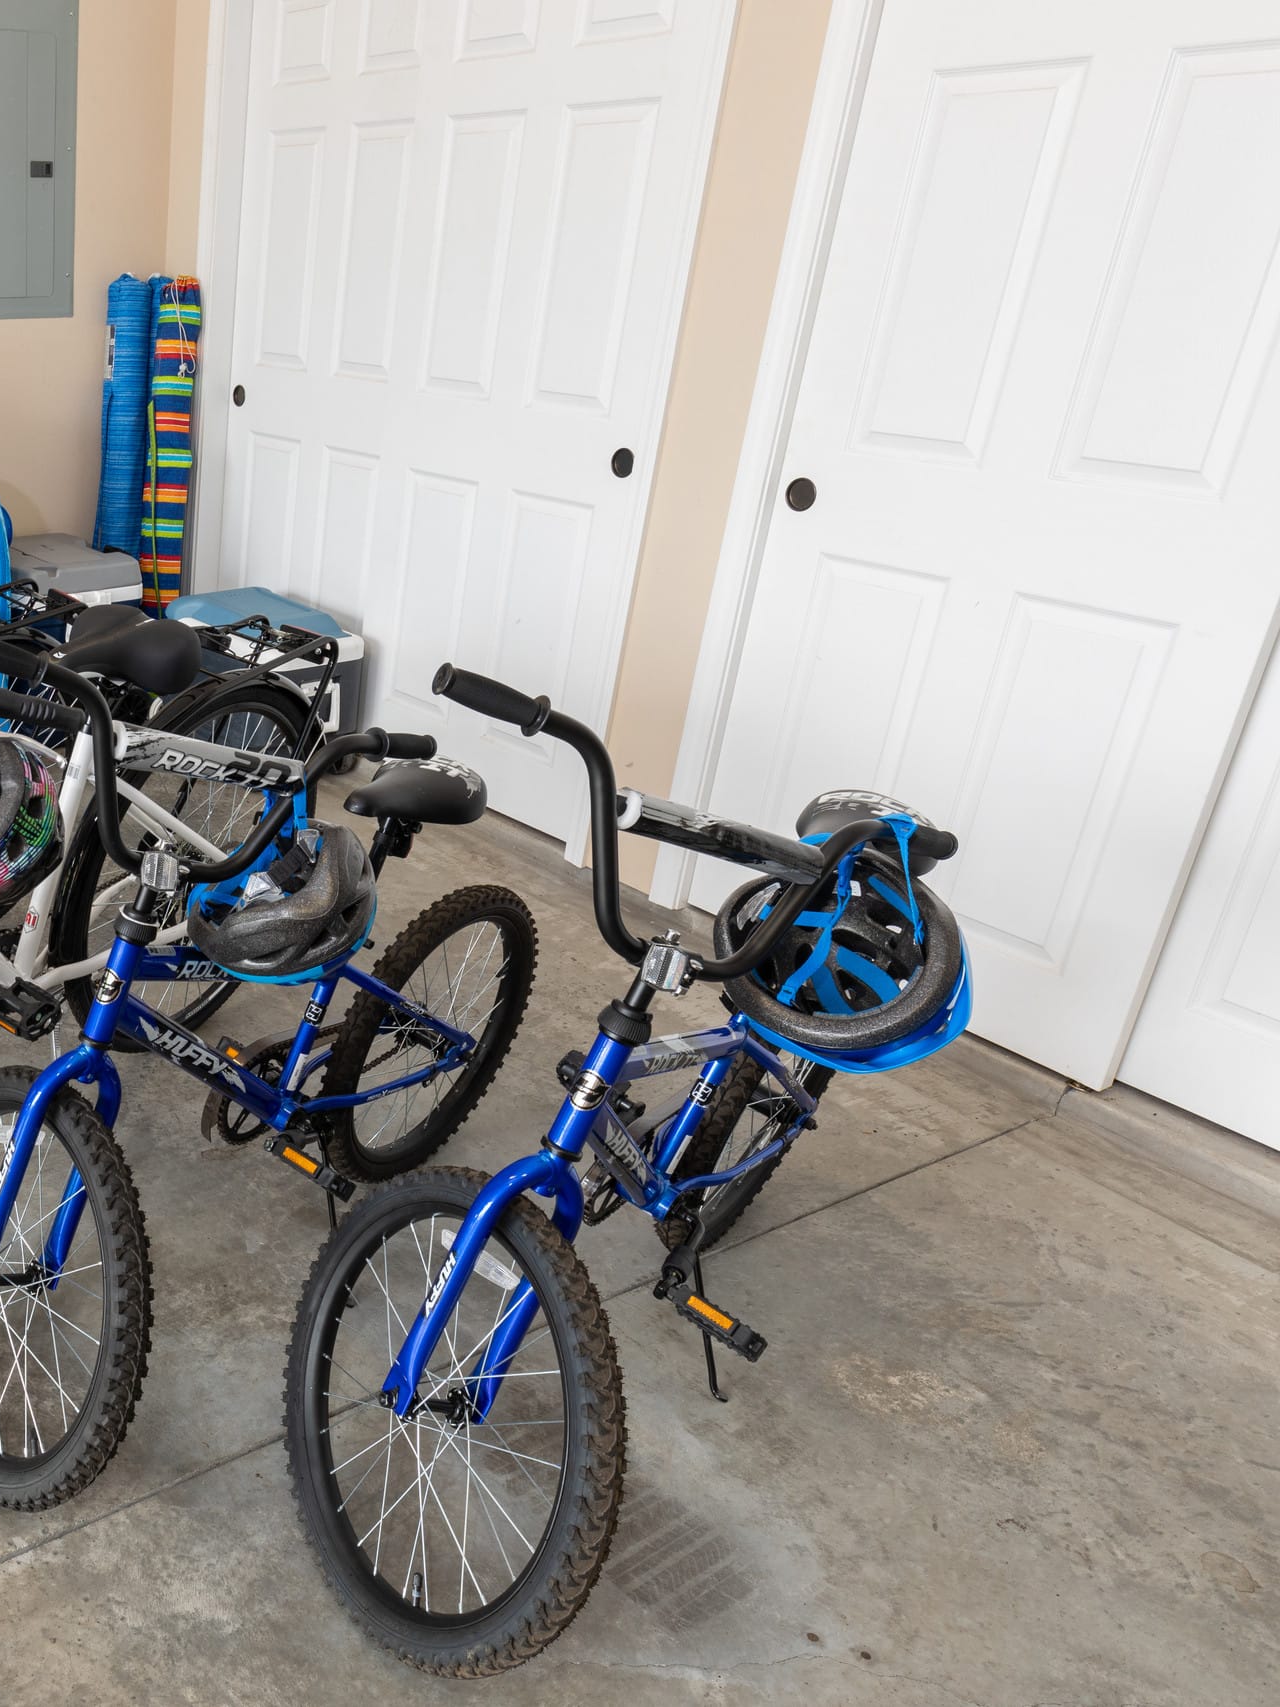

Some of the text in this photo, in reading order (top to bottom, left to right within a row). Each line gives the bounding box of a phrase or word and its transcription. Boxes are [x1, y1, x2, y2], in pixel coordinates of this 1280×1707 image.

[151, 748, 237, 782] ROCK
[154, 1029, 229, 1075] HUFFY
[605, 1129, 643, 1171] HUFFY
[425, 1252, 457, 1318] HUFFY
